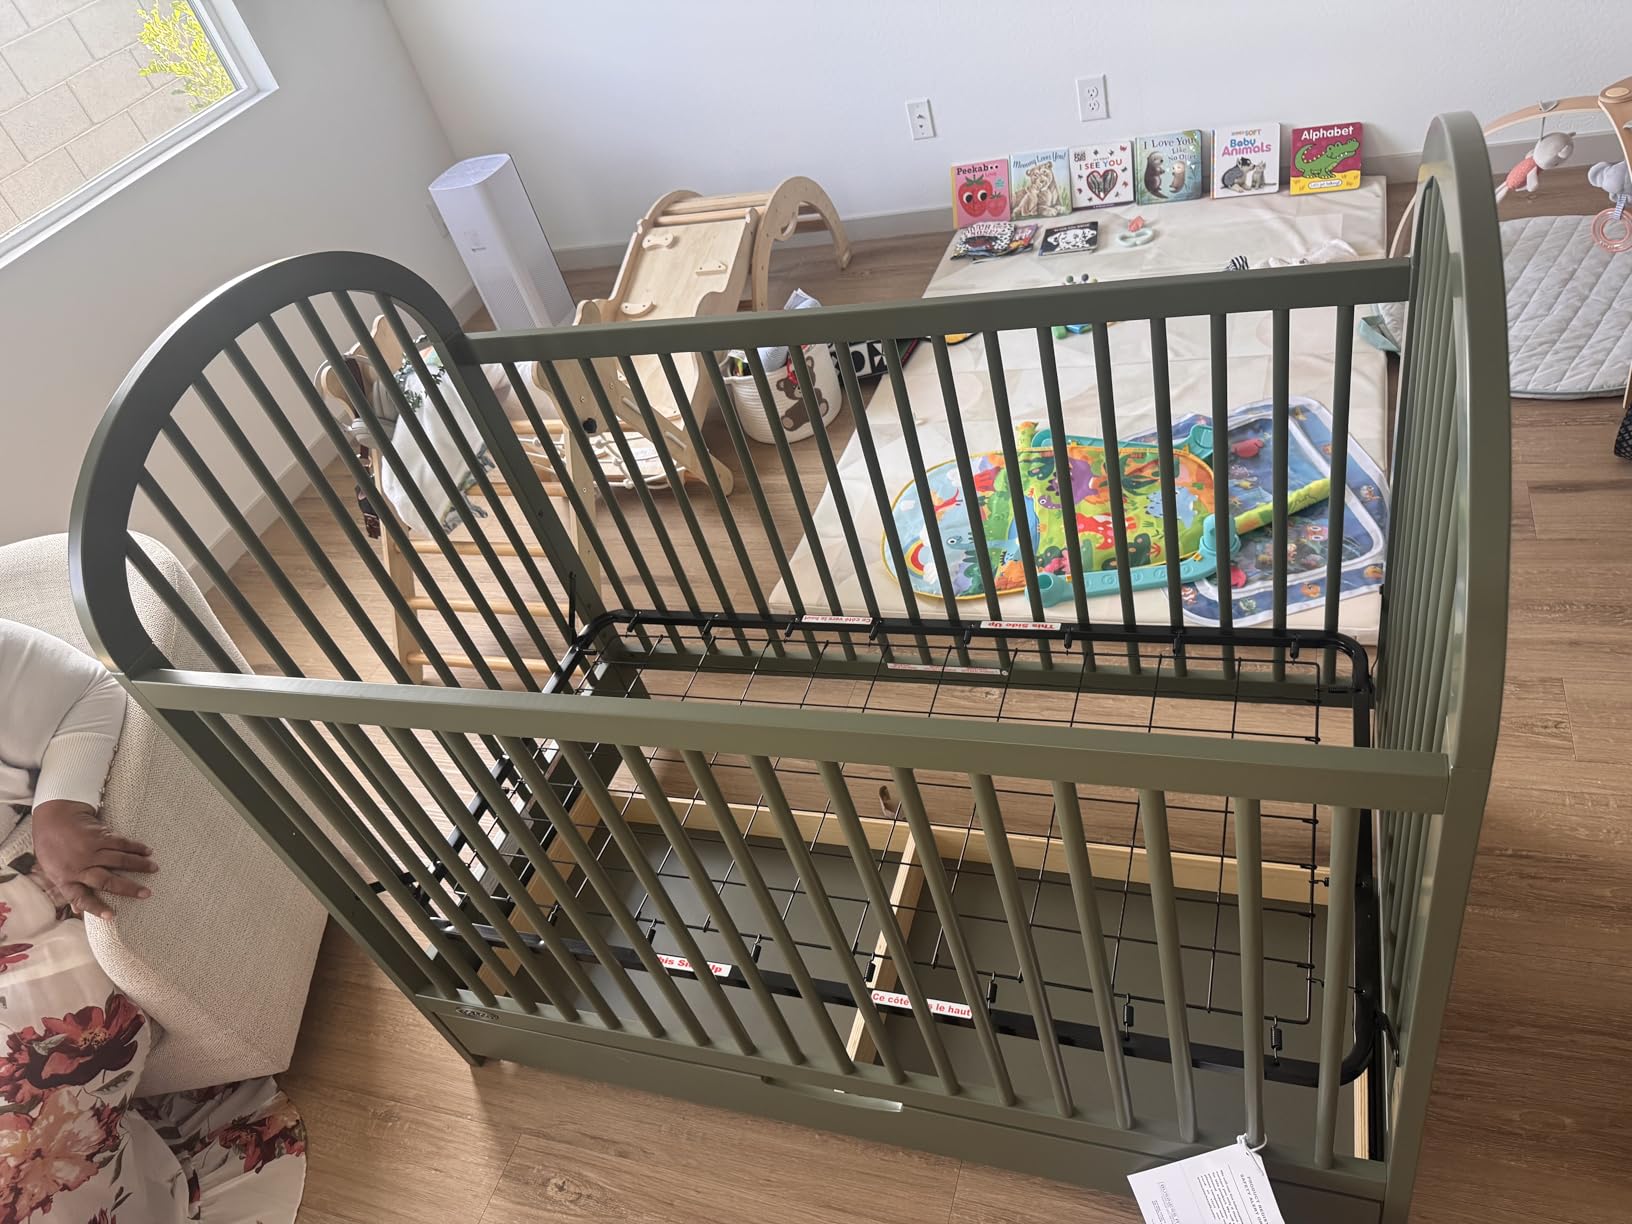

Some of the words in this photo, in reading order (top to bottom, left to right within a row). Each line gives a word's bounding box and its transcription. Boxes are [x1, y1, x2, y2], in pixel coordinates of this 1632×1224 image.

[1301, 126, 1354, 141] Alphabet
[1176, 137, 1196, 145] You
[1230, 138, 1256, 148] Baby
[1222, 142, 1272, 156] Animals
[1084, 161, 1101, 170] SEE
[1103, 159, 1123, 168] YOU
[658, 956, 674, 965] his
[873, 993, 885, 1002] Ce
[936, 1003, 945, 1012] le
[948, 1006, 971, 1017] haut
[1240, 1174, 1251, 1195] SAFETY
[1249, 1196, 1259, 1215] ALERT
[1247, 1176, 1260, 1203] PRODUCT
